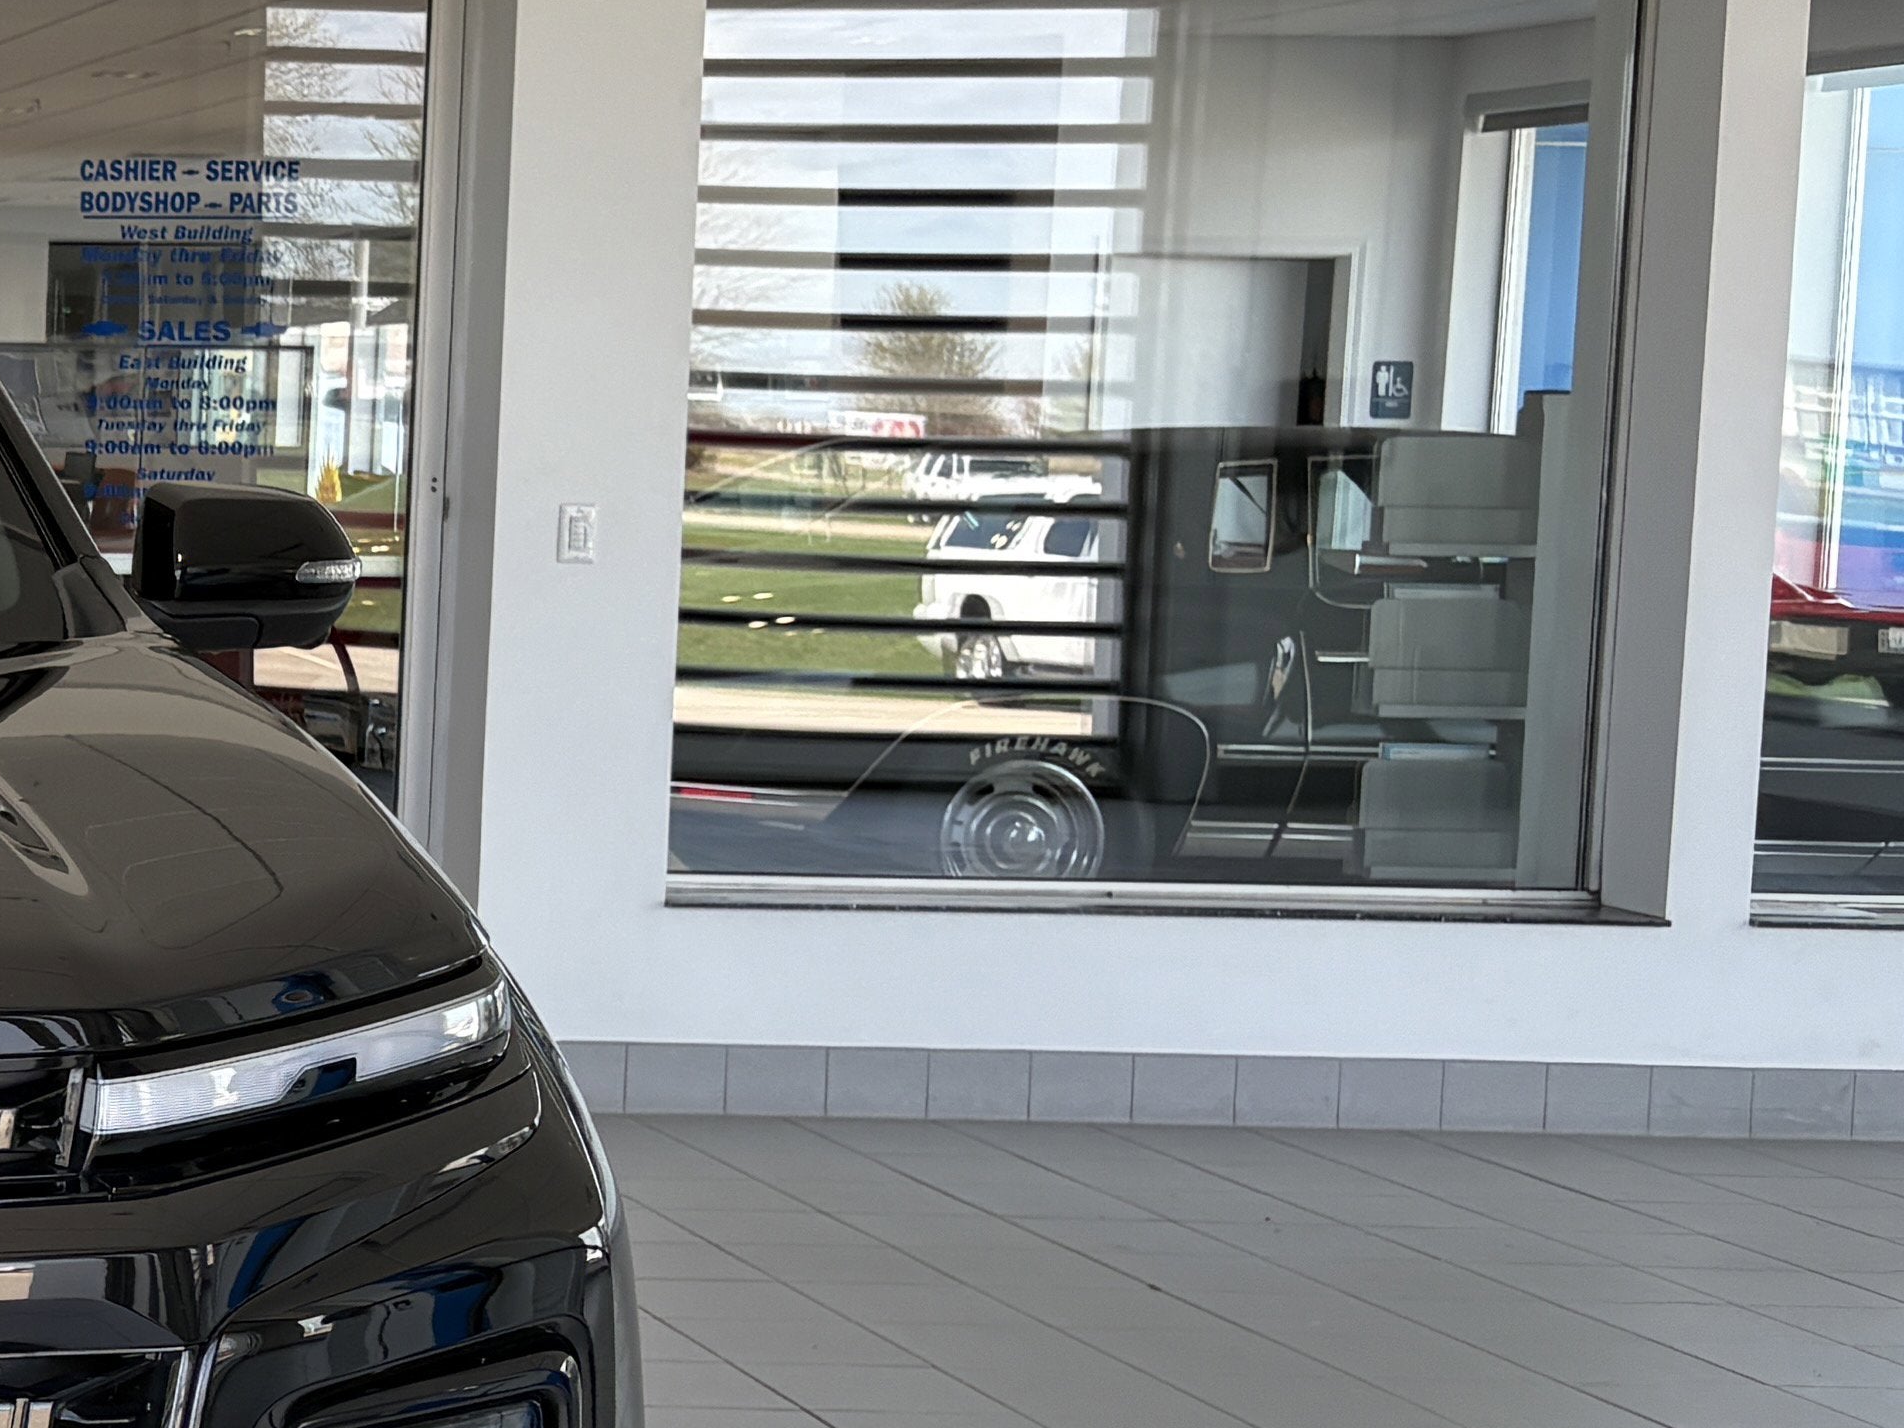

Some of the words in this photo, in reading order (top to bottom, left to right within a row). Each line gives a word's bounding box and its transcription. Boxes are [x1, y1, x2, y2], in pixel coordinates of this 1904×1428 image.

[80, 159, 177, 182] CASHIER
[205, 160, 301, 182] SERVICE
[80, 191, 201, 214] BODYSHOP
[229, 192, 299, 214] PARTS
[120, 225, 168, 240] West
[174, 224, 254, 244] Building
[139, 320, 231, 341] SALES
[119, 354, 160, 371] East
[168, 354, 248, 373] Building
[145, 377, 212, 392] Monday
[171, 396, 191, 411] to
[97, 418, 166, 434] Tuesday
[173, 419, 207, 432] thru
[212, 419, 265, 436] Friday
[169, 440, 189, 456] to
[137, 467, 216, 483] Saturday
[969, 735, 1107, 778] FIREHAWK
